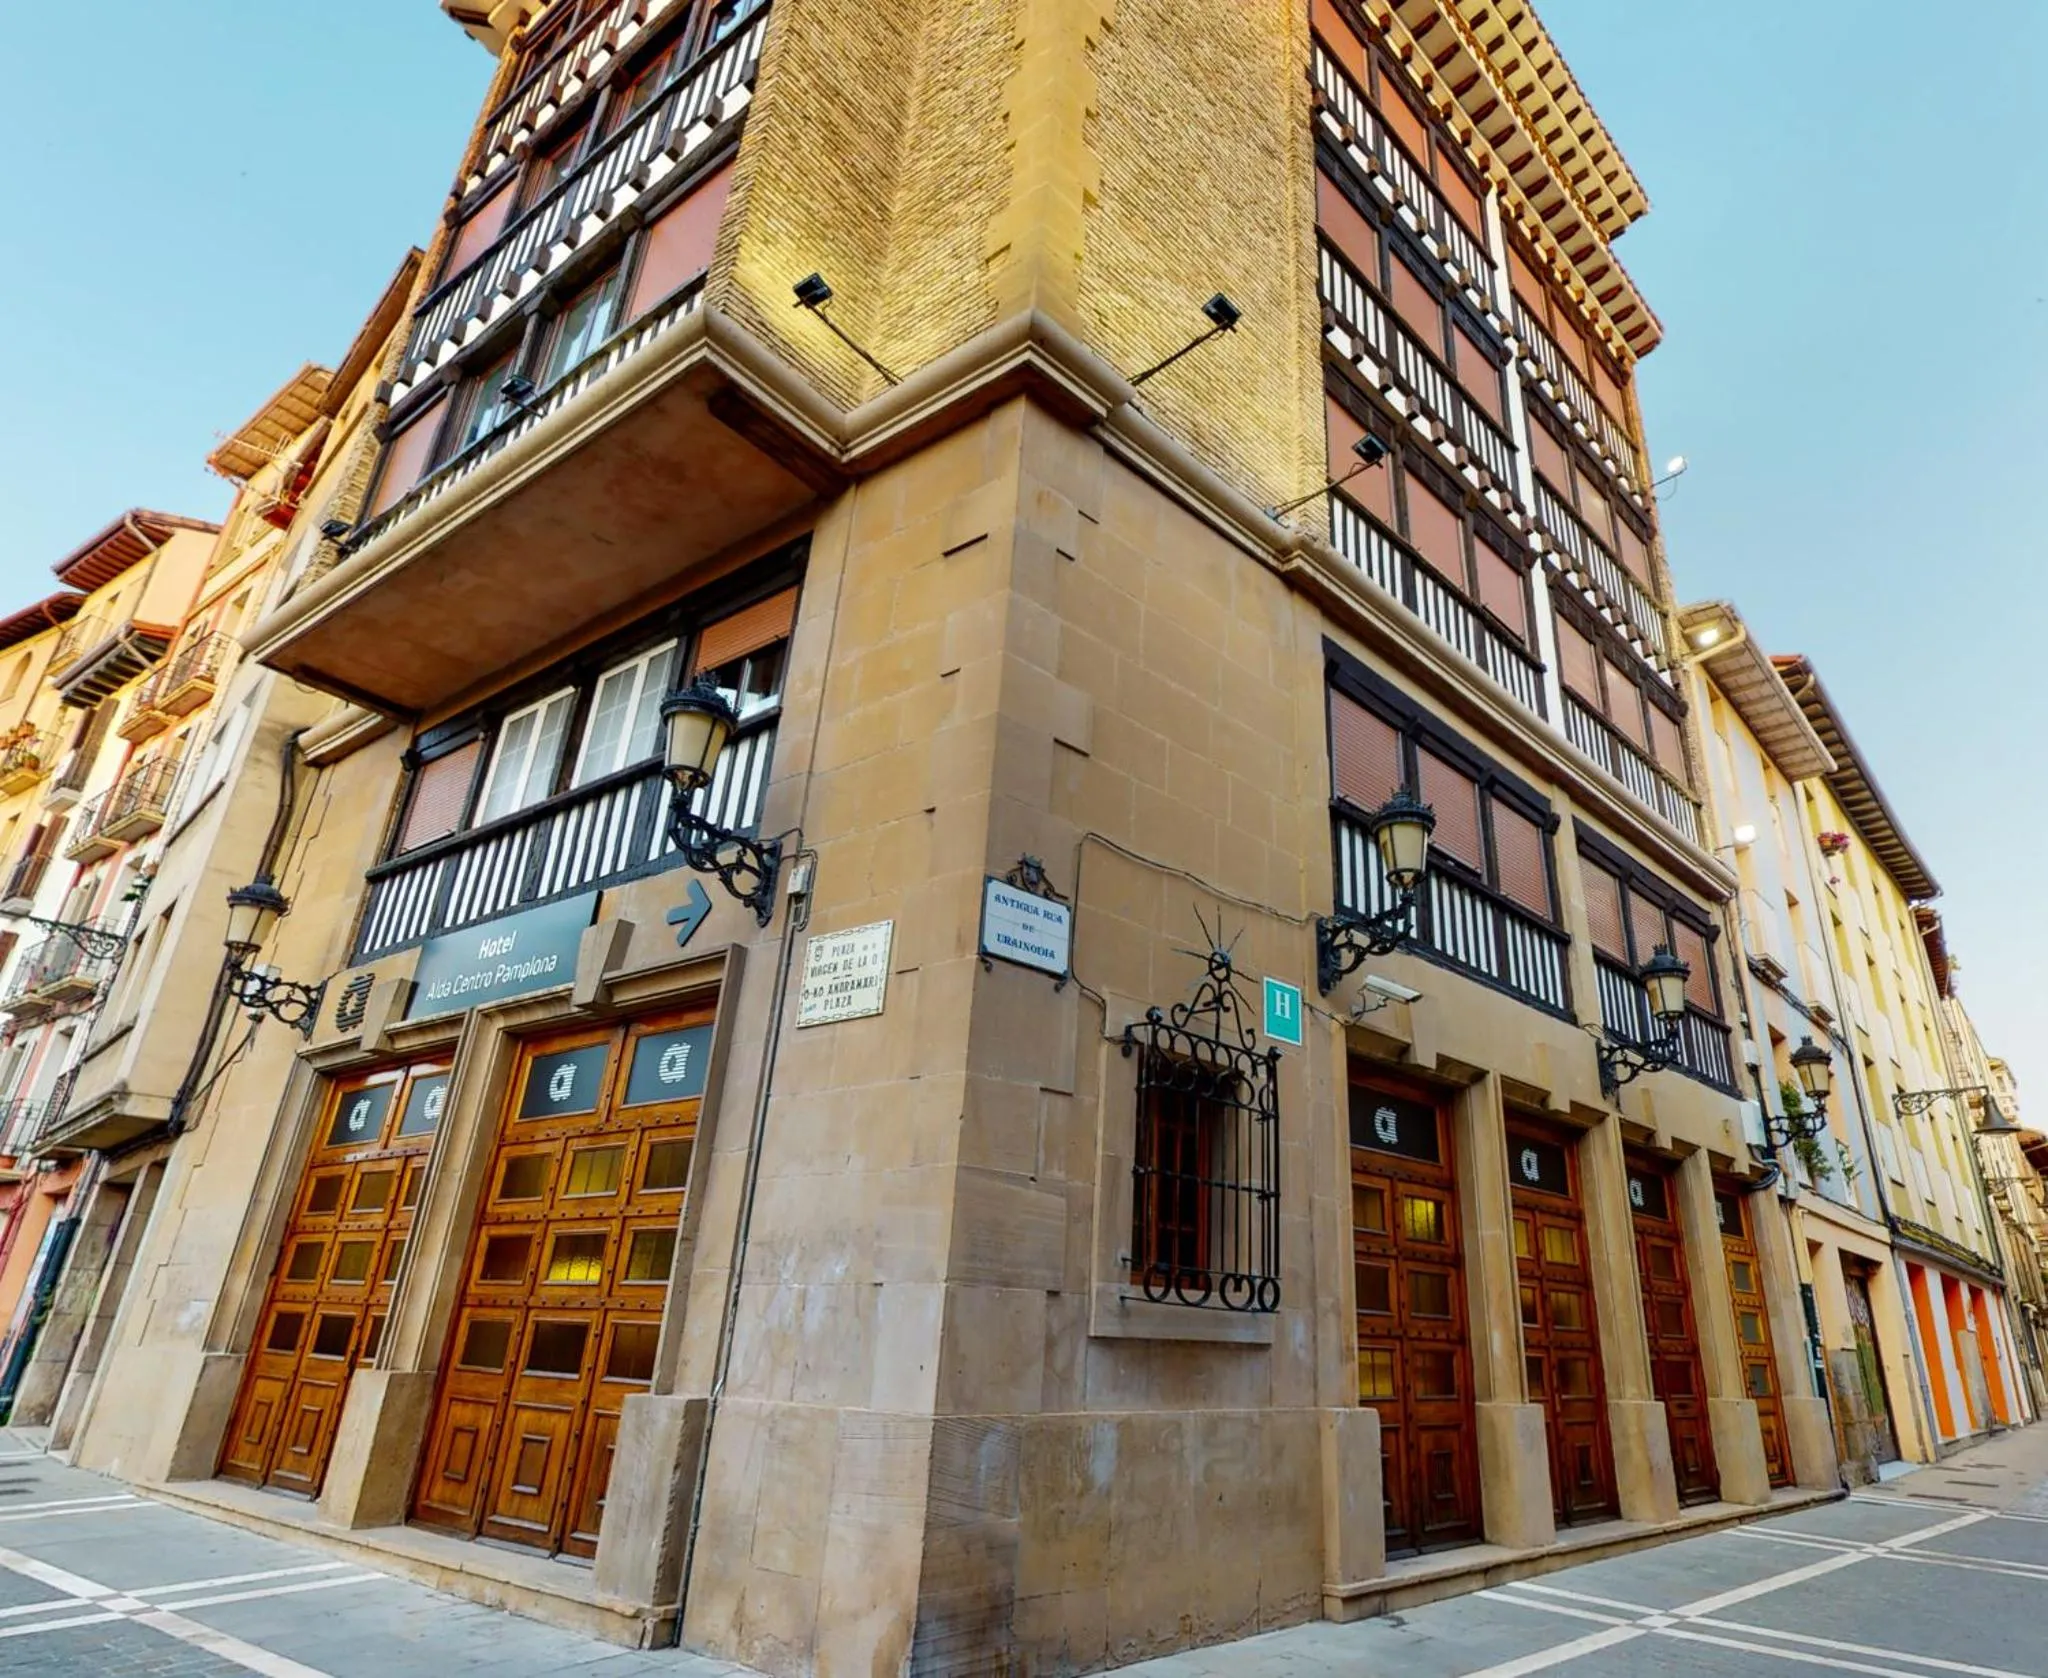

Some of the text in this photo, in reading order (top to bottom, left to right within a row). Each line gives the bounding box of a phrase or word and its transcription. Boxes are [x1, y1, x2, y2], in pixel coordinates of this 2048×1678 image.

[994, 894, 1040, 916] ANTIGUA
[1022, 922, 1035, 934] DE
[478, 930, 518, 960] Hotel
[831, 942, 856, 958] PLAZA
[426, 954, 558, 1001] Alda Centro Pamplona
[810, 962, 838, 978] VIRGEN
[842, 957, 854, 971] DE
[857, 955, 868, 968] LA
[827, 975, 879, 995] ANDRAMARI
[823, 995, 853, 1010] PLAZA
[1273, 988, 1292, 1020] H
